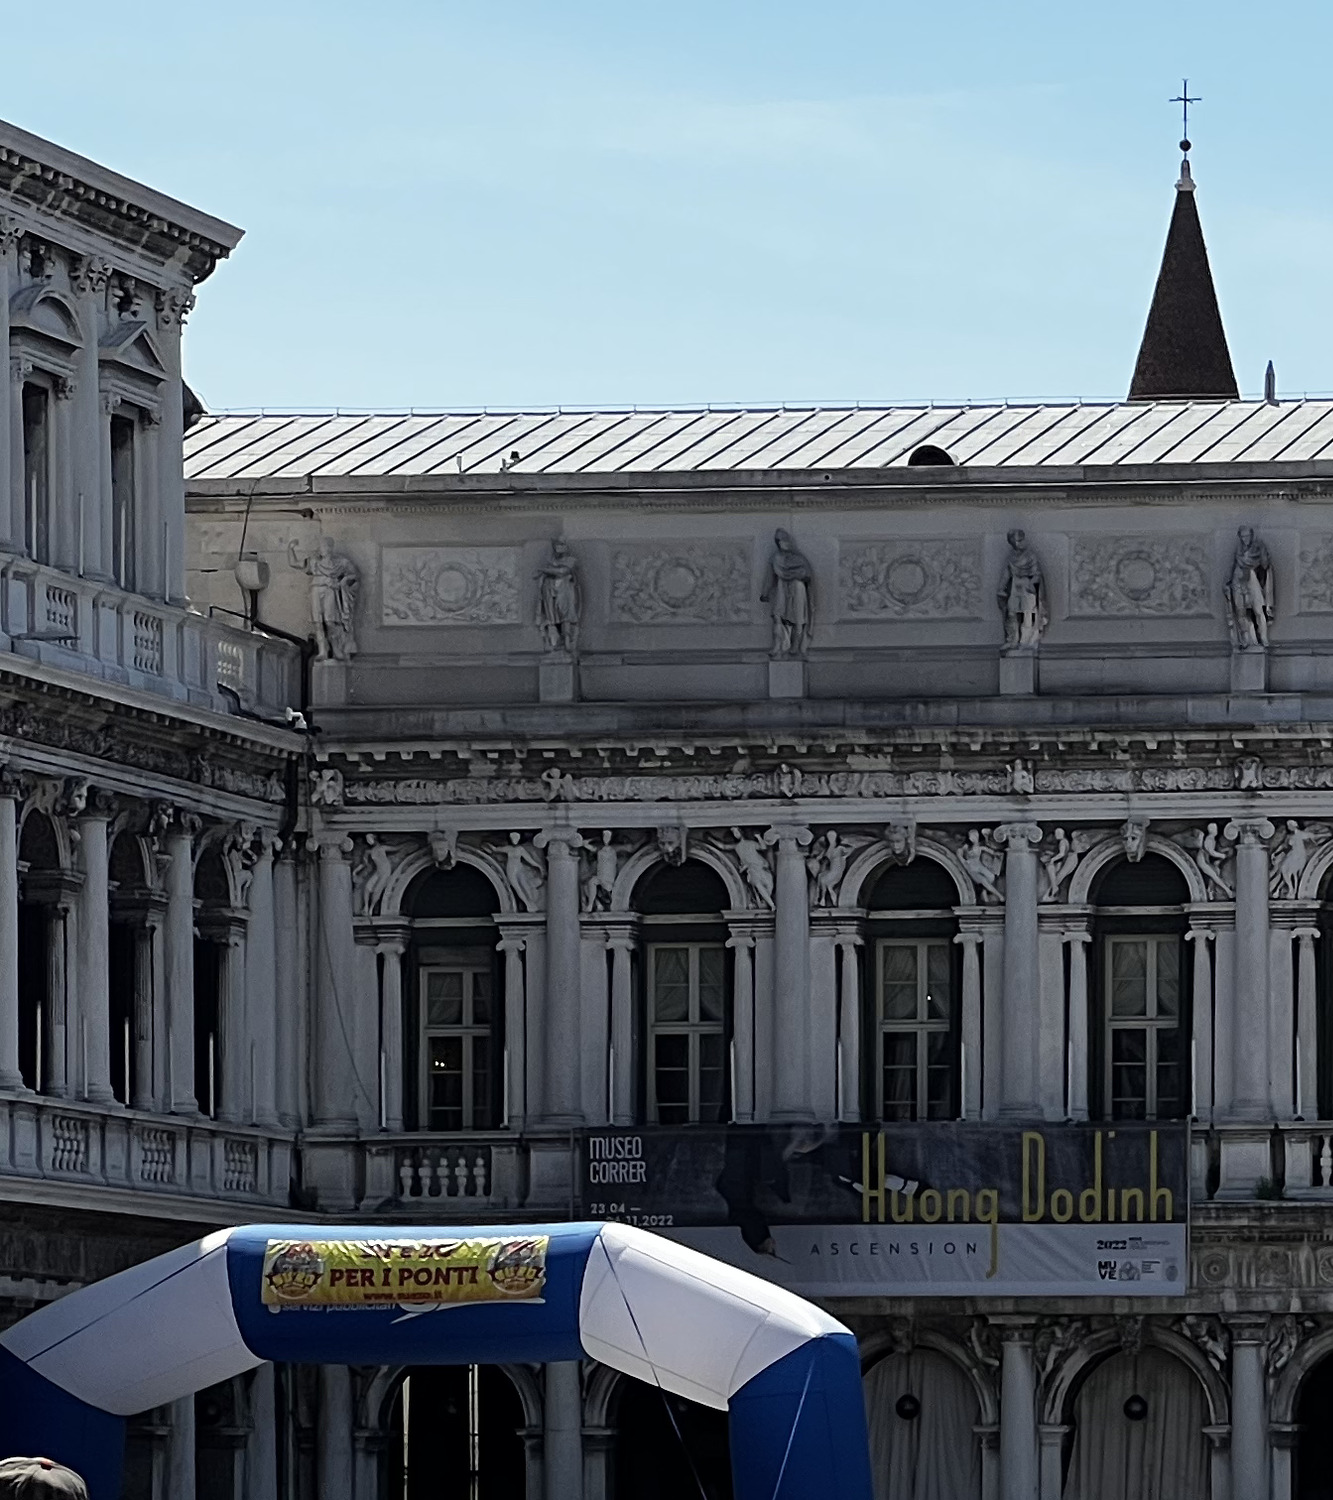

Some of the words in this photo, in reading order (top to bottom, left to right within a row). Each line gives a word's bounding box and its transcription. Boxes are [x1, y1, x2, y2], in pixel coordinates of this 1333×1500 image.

[589, 1136, 642, 1160] MUSEO
[589, 1161, 647, 1184] CORRER
[862, 1131, 998, 1279] Huong
[1021, 1130, 1173, 1222] Dodinh
[810, 1242, 978, 1256] ASCENSION
[1096, 1240, 1127, 1250] 2022
[329, 1266, 376, 1288] PER
[382, 1266, 391, 1287] I
[399, 1265, 479, 1287] PONTI
